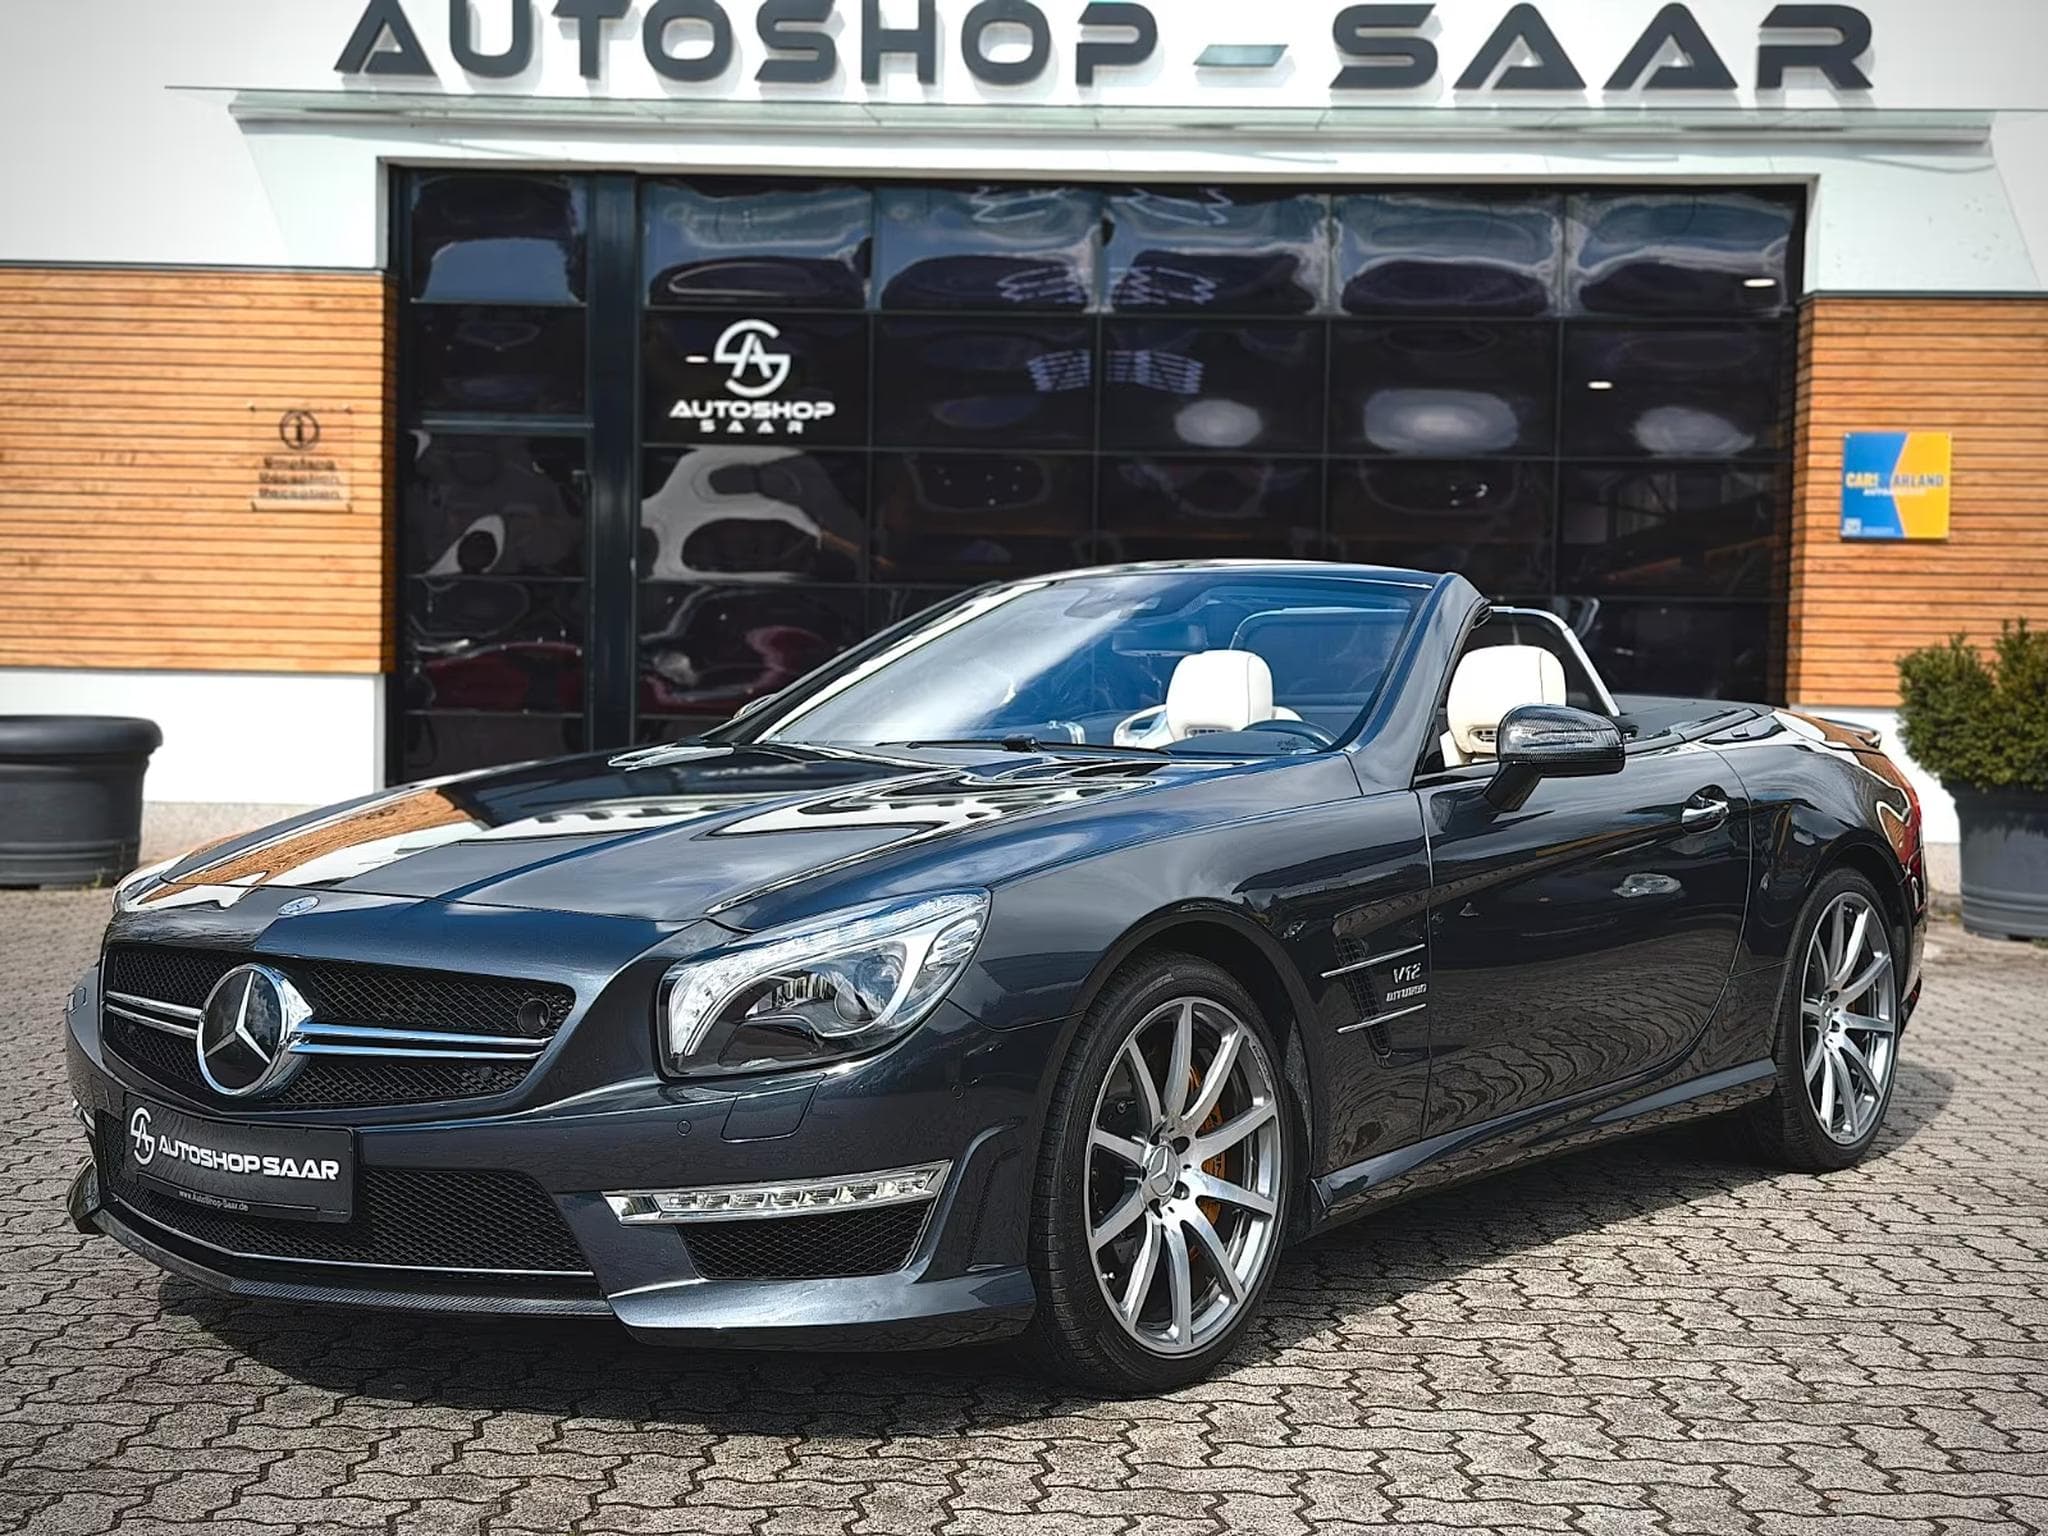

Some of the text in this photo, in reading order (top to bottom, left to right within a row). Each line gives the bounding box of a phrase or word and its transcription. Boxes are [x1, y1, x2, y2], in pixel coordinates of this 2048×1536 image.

[334, 0, 1159, 86] AUTOSHOP
[1329, 2, 1875, 90] SAAR
[669, 399, 835, 420] AUTOSHOP
[700, 419, 804, 434] SAAR
[1393, 962, 1422, 984] V12
[158, 1134, 340, 1181] AUTOSHOP SAAR
